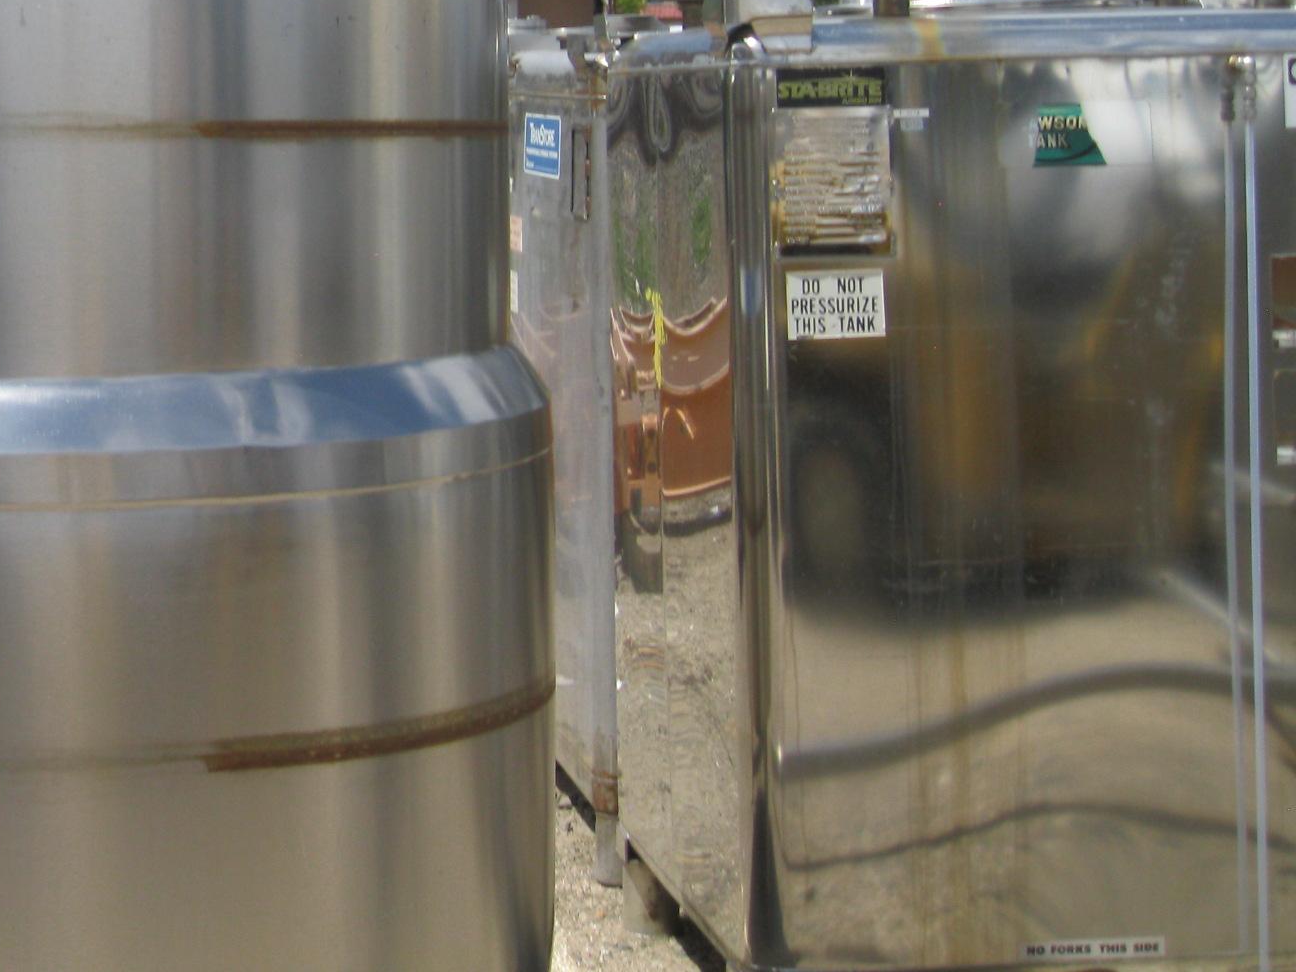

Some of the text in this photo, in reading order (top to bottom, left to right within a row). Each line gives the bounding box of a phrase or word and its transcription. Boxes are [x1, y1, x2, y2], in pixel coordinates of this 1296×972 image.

[802, 276, 865, 295] DO NOT
[791, 296, 879, 315] PRESSURIZE
[795, 315, 875, 335] THIS TANK
[1026, 942, 1160, 956] NO FORKS THIS SIDE
